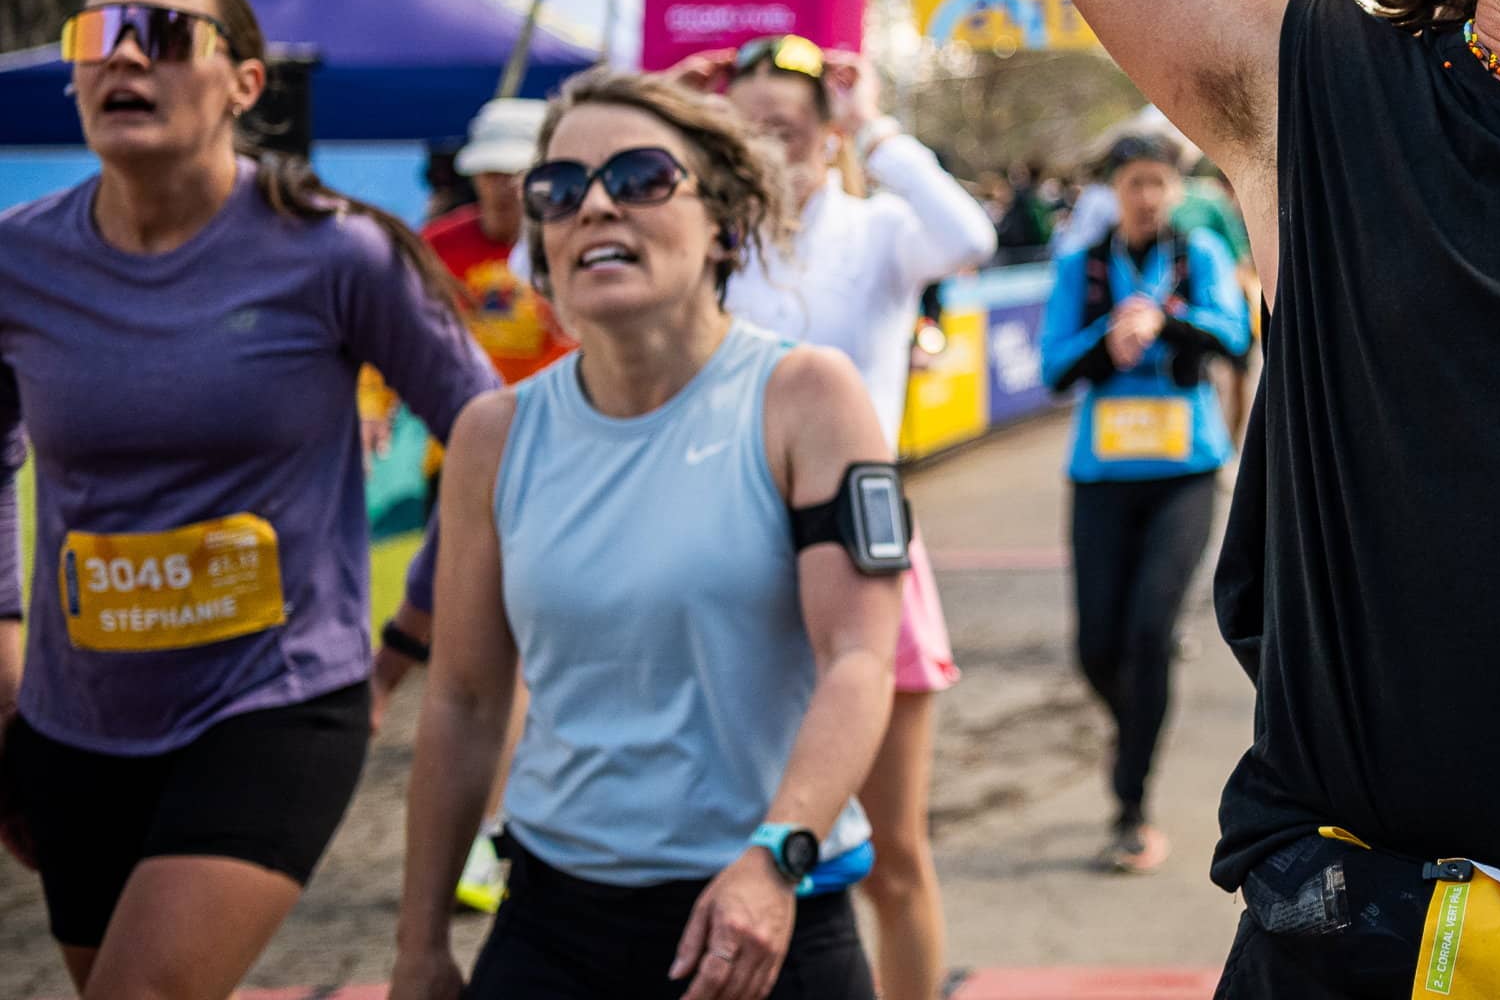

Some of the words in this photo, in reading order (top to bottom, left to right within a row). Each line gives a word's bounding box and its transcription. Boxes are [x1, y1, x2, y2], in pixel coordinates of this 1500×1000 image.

[85, 554, 193, 593] 3046
[100, 595, 236, 632] STÉPHANIE
[1446, 905, 1458, 928] VERT
[1436, 930, 1454, 973] CORRAL
[1433, 980, 1443, 988] 2
